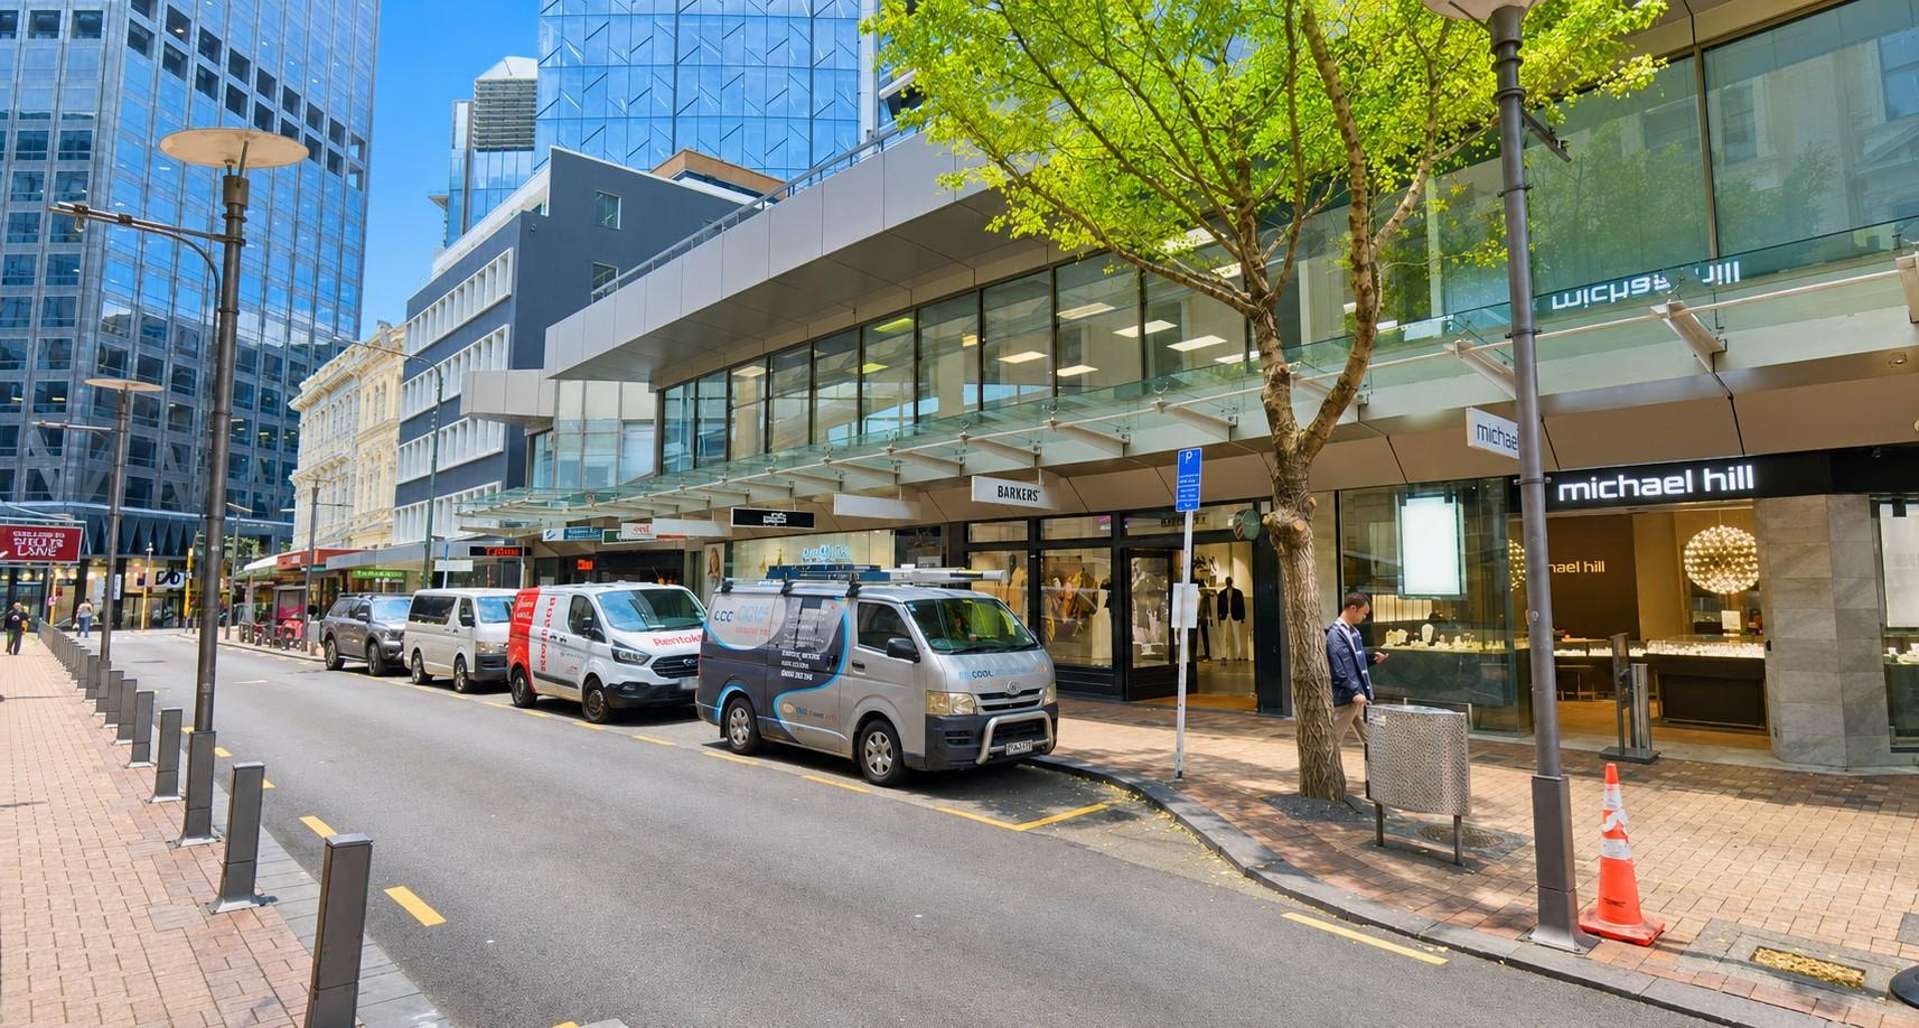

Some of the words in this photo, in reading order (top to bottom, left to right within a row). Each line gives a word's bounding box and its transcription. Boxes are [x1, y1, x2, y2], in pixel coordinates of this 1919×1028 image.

[1558, 469, 1693, 501] michael
[1703, 464, 1755, 491] hill
[997, 485, 1039, 502] BARKERS
[1583, 560, 1605, 573] hill
